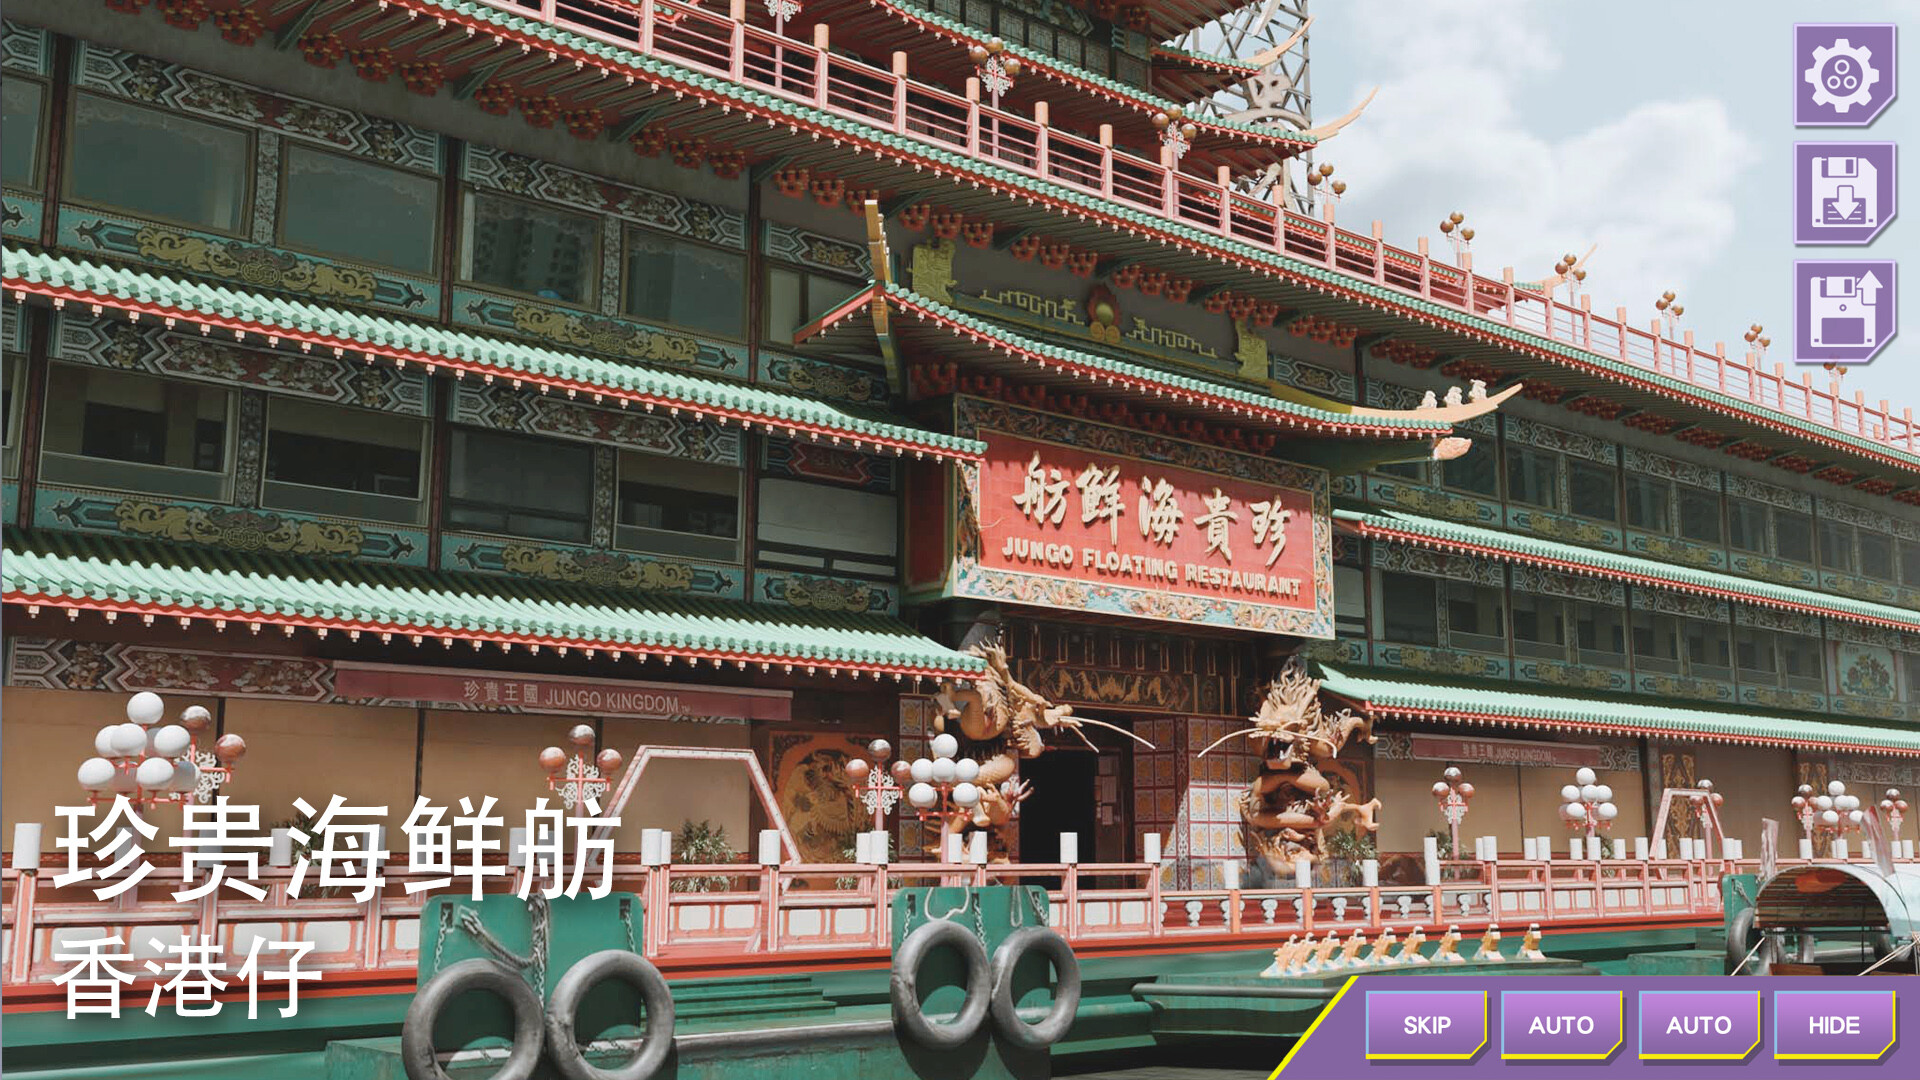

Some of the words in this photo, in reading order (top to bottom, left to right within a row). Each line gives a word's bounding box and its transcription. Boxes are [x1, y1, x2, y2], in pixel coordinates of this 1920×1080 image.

[1002, 536, 1074, 565] JUNGO
[1082, 548, 1178, 581] FLOATING
[1185, 563, 1302, 597] RESTAURANT
[463, 680, 538, 704] 珍貴王國
[545, 689, 601, 707] JUNGO
[606, 693, 679, 713] KINGDOM
